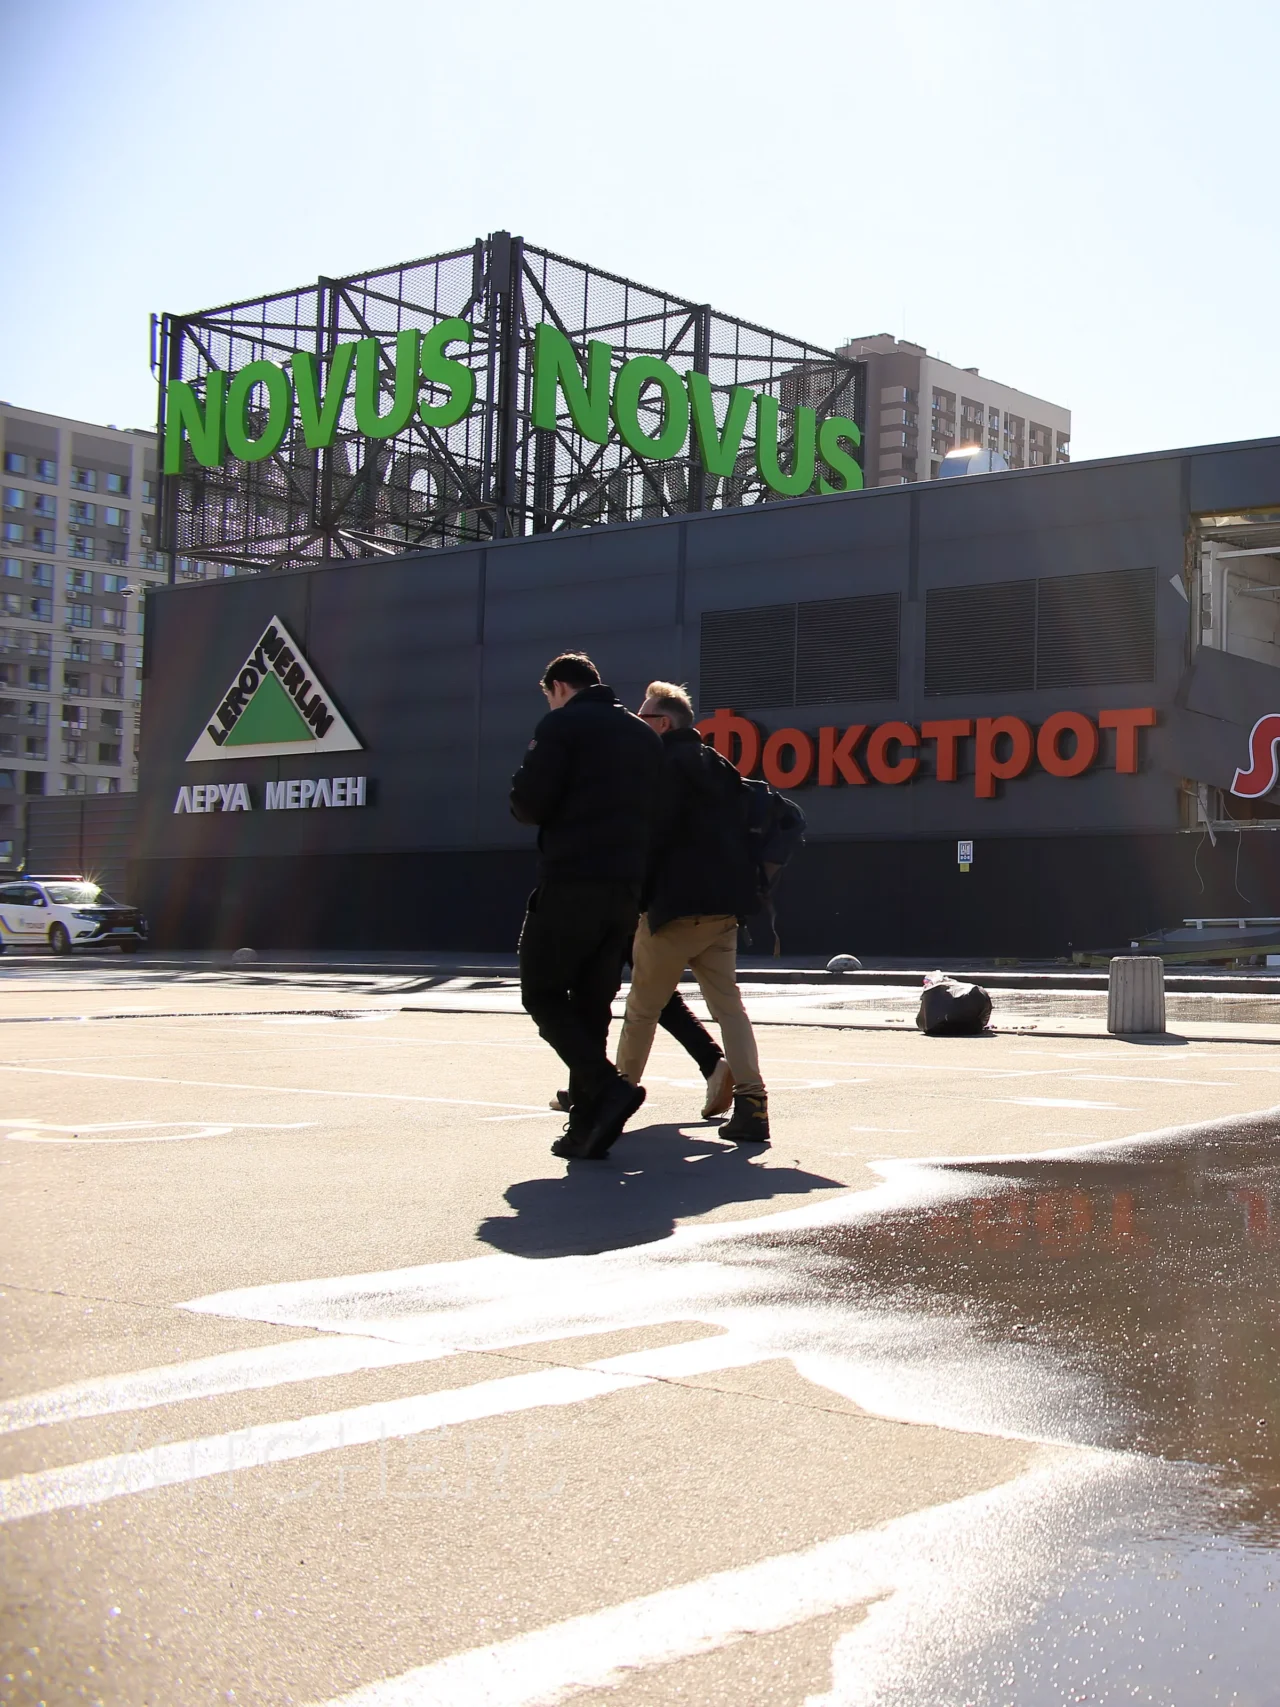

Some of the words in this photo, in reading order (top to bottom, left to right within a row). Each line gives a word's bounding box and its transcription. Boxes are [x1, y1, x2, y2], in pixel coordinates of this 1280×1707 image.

[164, 317, 476, 475] NOVUS
[532, 322, 864, 496] NOVUS
[207, 646, 268, 746] LEROY
[259, 625, 335, 739] MERLIN
[694, 708, 1156, 799] Фокстрот
